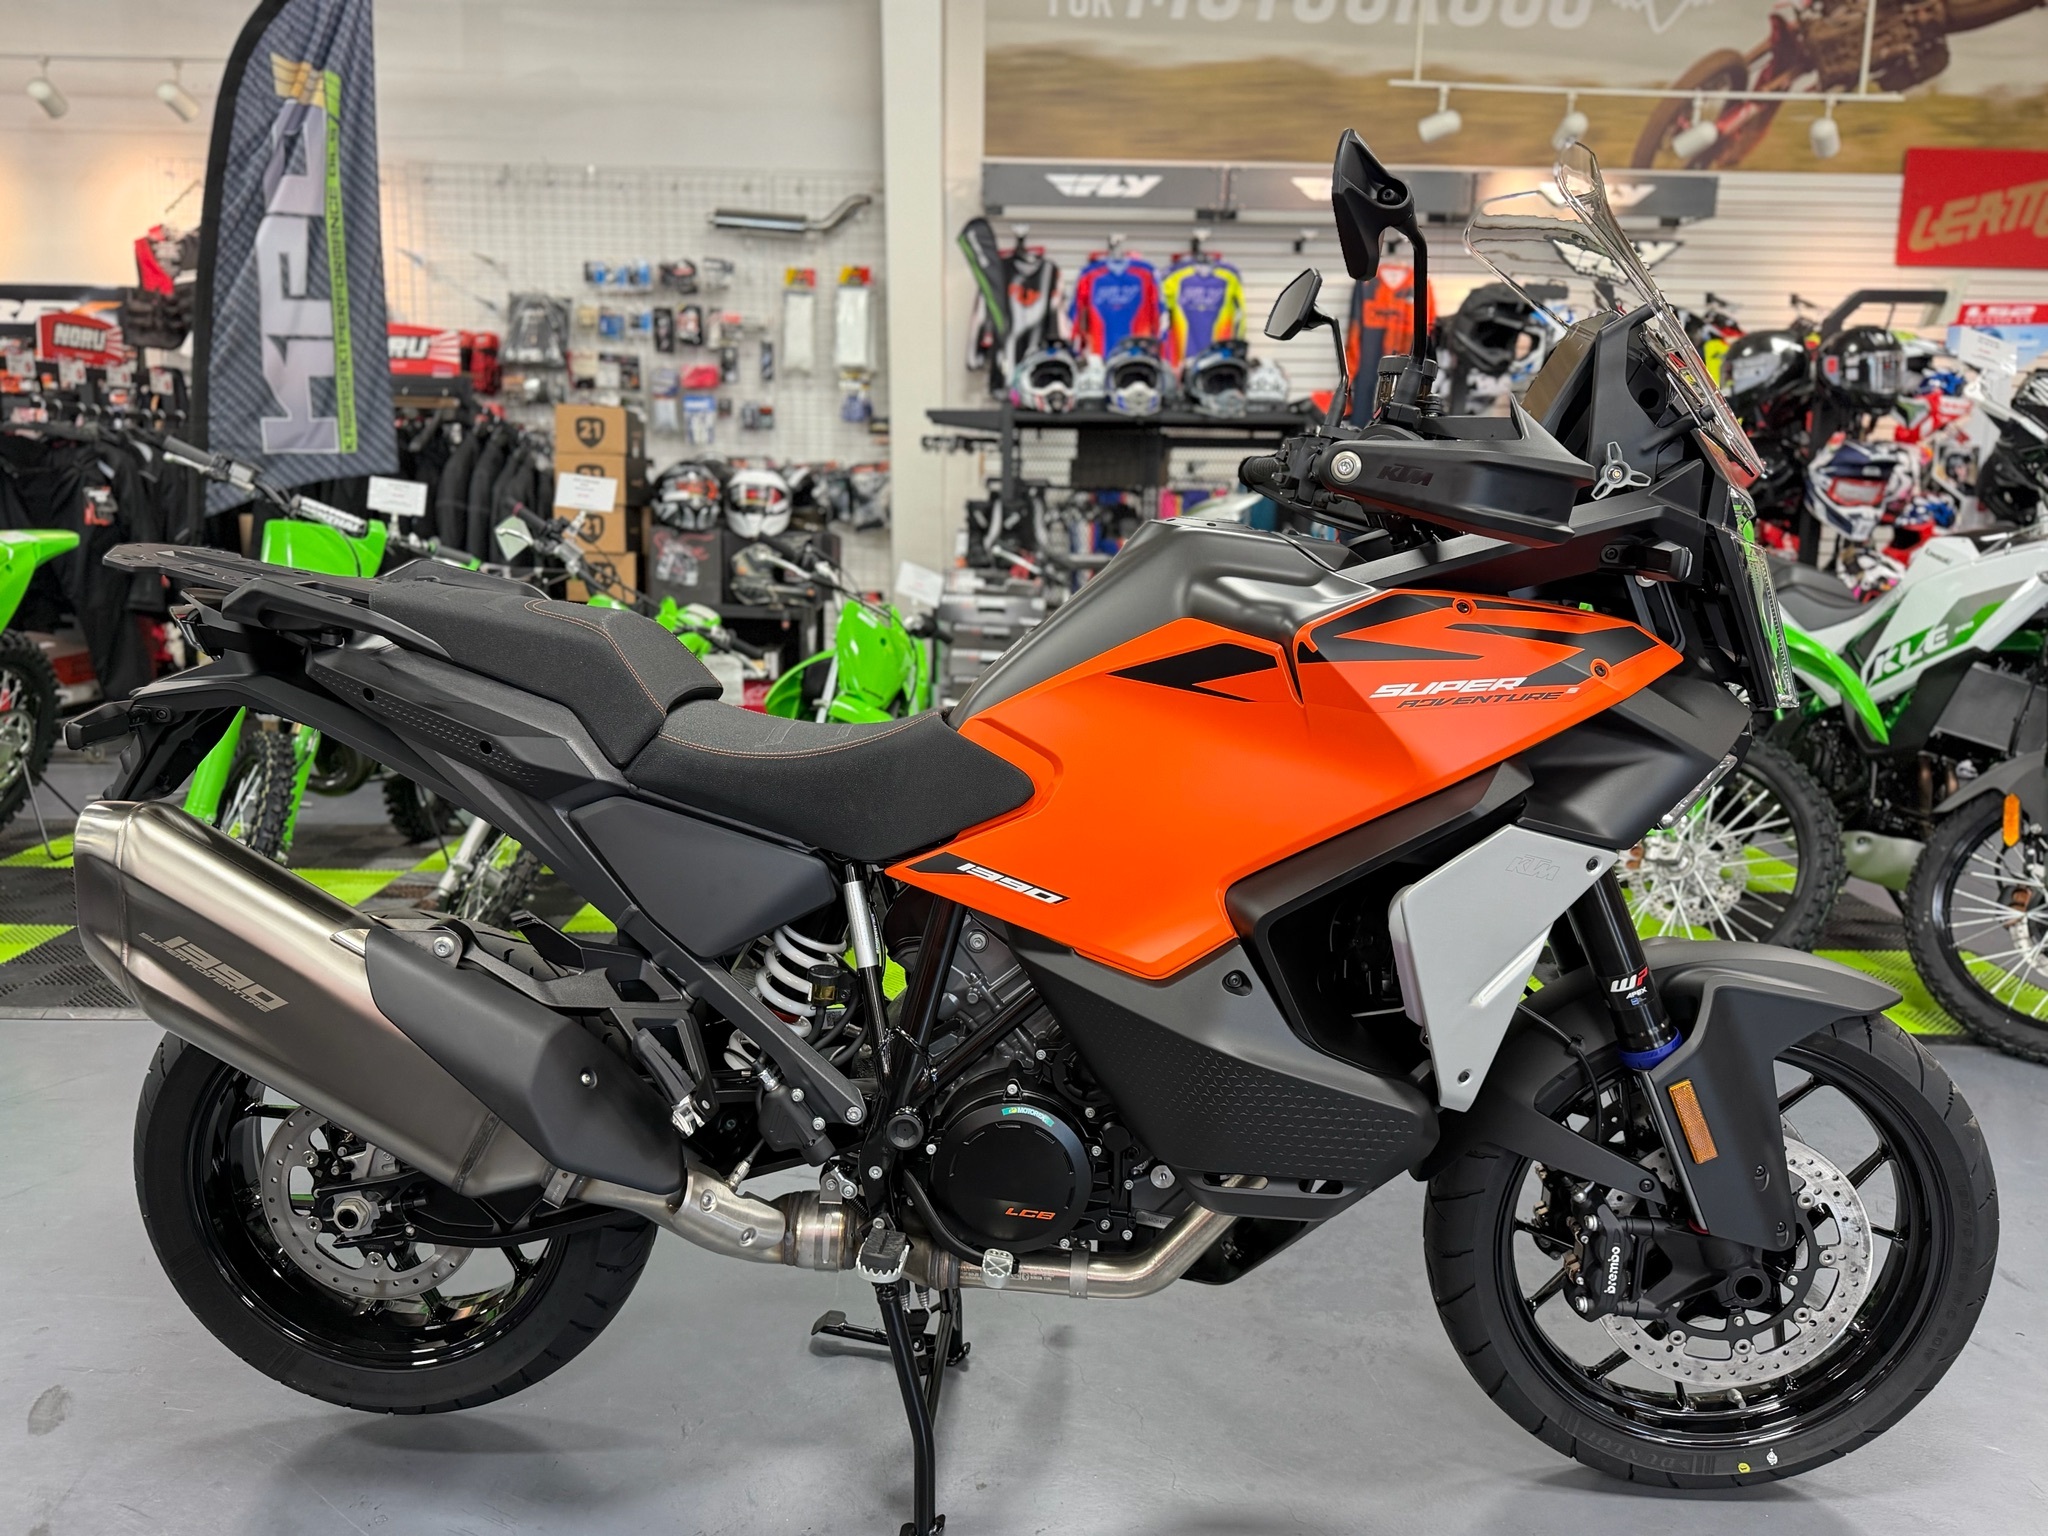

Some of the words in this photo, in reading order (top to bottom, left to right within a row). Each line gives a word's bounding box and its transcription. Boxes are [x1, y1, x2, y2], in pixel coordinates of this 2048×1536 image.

[1044, 173, 1163, 199] FLY
[328, 186, 347, 346] PERFORMANCE
[53, 322, 107, 352] NORU
[579, 419, 600, 436] 21
[1376, 463, 1434, 487] KTM
[1872, 623, 1949, 681] KLE
[1369, 676, 1528, 699] SUPER
[1397, 691, 1564, 709] ADVENTURE
[1505, 854, 1561, 881] KTM
[956, 862, 1064, 904] 1390
[138, 932, 187, 963] SUPER
[186, 961, 272, 1013] ADVENTURE
[163, 935, 289, 1011] 1390
[1610, 966, 1649, 993] WP
[1625, 986, 1648, 1000] APEX
[1005, 1207, 1056, 1220] LC8
[1604, 1246, 1621, 1295] brembo
[1581, 1424, 1676, 1469] DUNLOP
